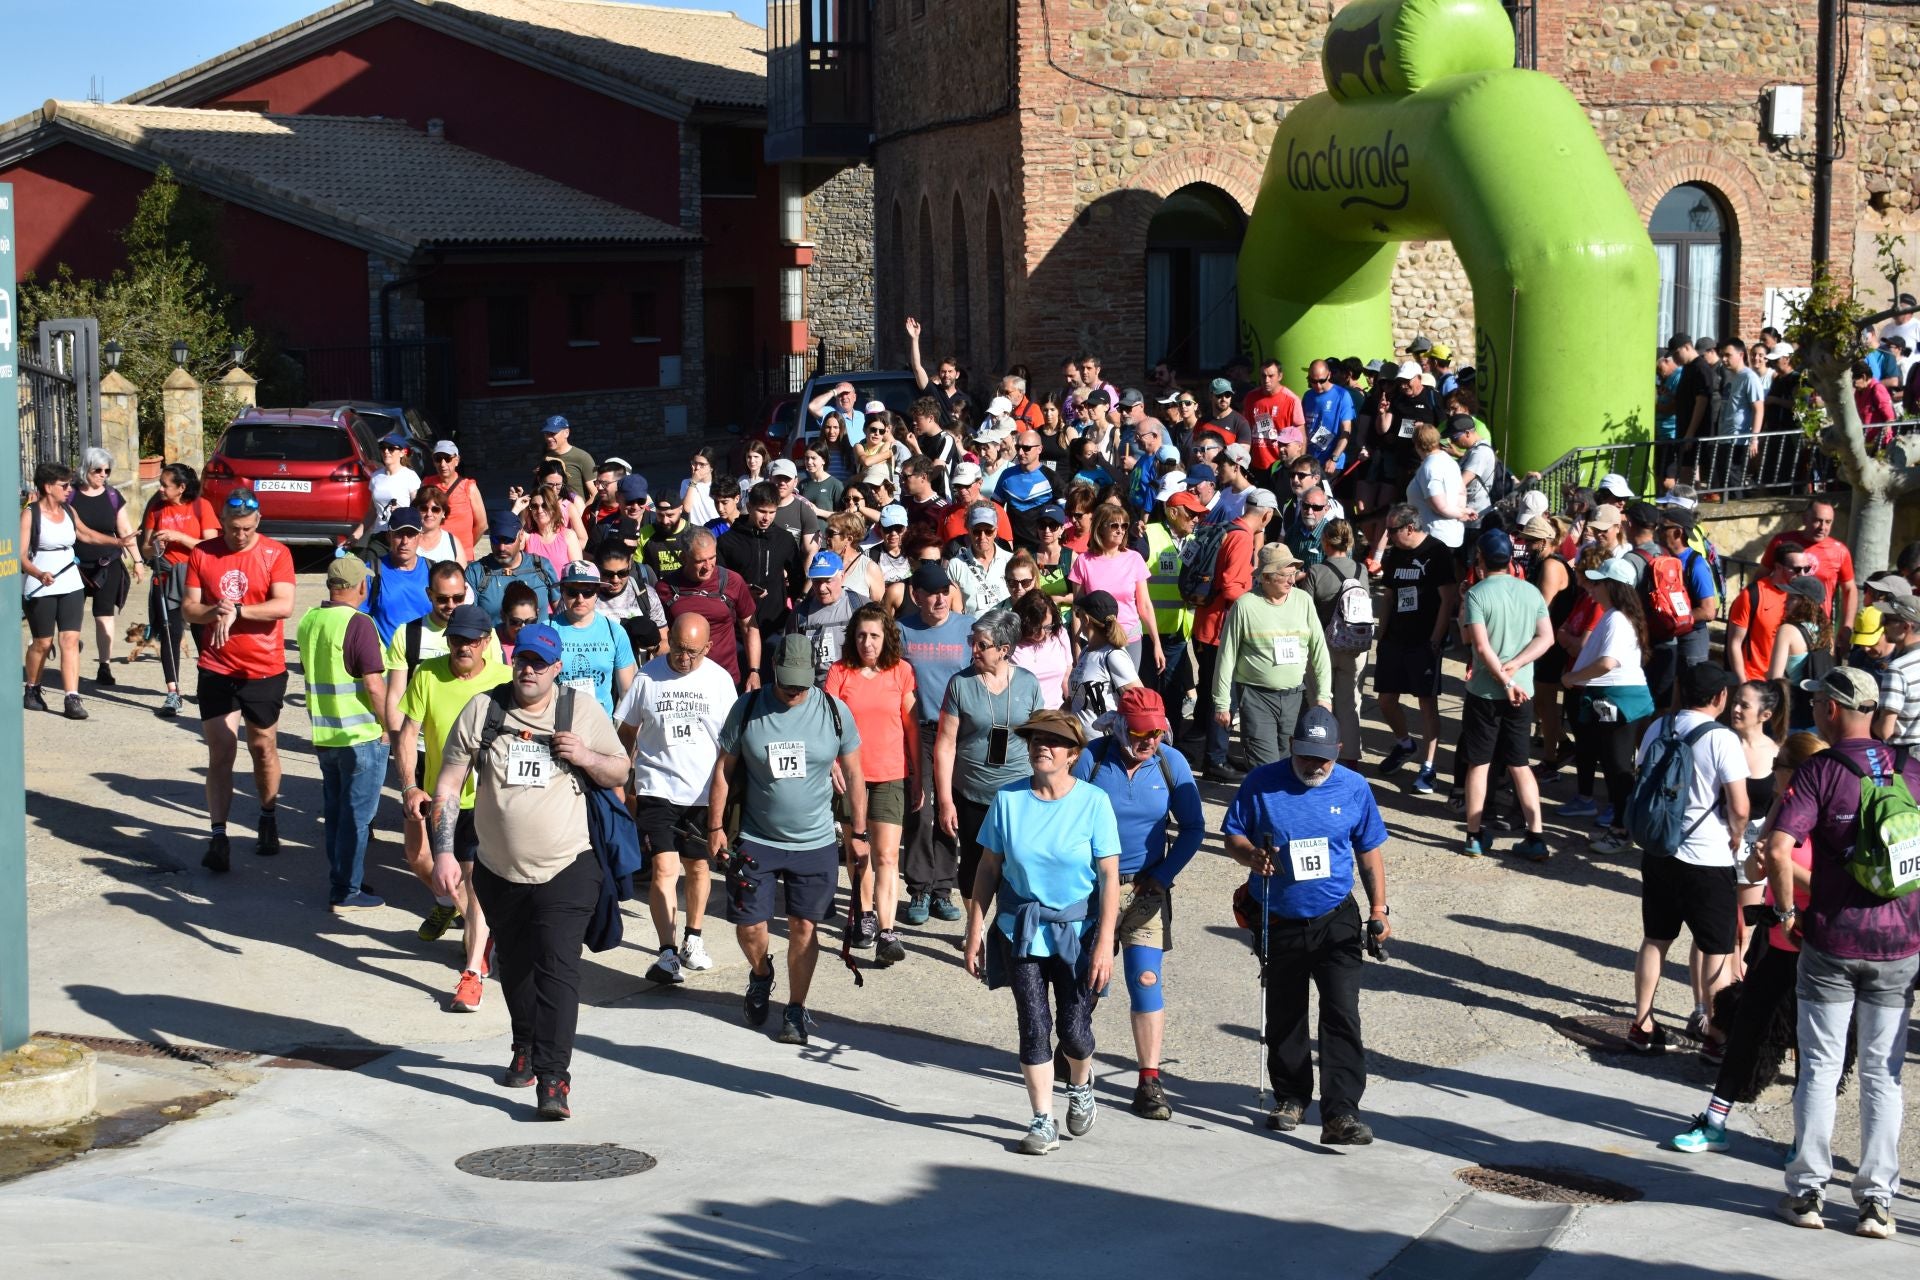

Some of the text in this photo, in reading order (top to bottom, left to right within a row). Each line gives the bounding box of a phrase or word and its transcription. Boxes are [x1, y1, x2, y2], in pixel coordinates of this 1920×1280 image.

[1287, 129, 1409, 209] lacturale
[261, 481, 309, 491] 6264 KNS
[1393, 568, 1420, 580] PUMA
[1401, 596, 1415, 608] 290
[662, 691, 704, 700] XX MARCHA
[672, 724, 691, 739] 164
[511, 744, 520, 752] LA
[521, 744, 541, 753] VILLA
[778, 742, 796, 750] VILLA
[518, 760, 541, 777] 176
[779, 756, 798, 771] 175
[1299, 839, 1318, 848] VILLA
[1300, 855, 1321, 872] 163
